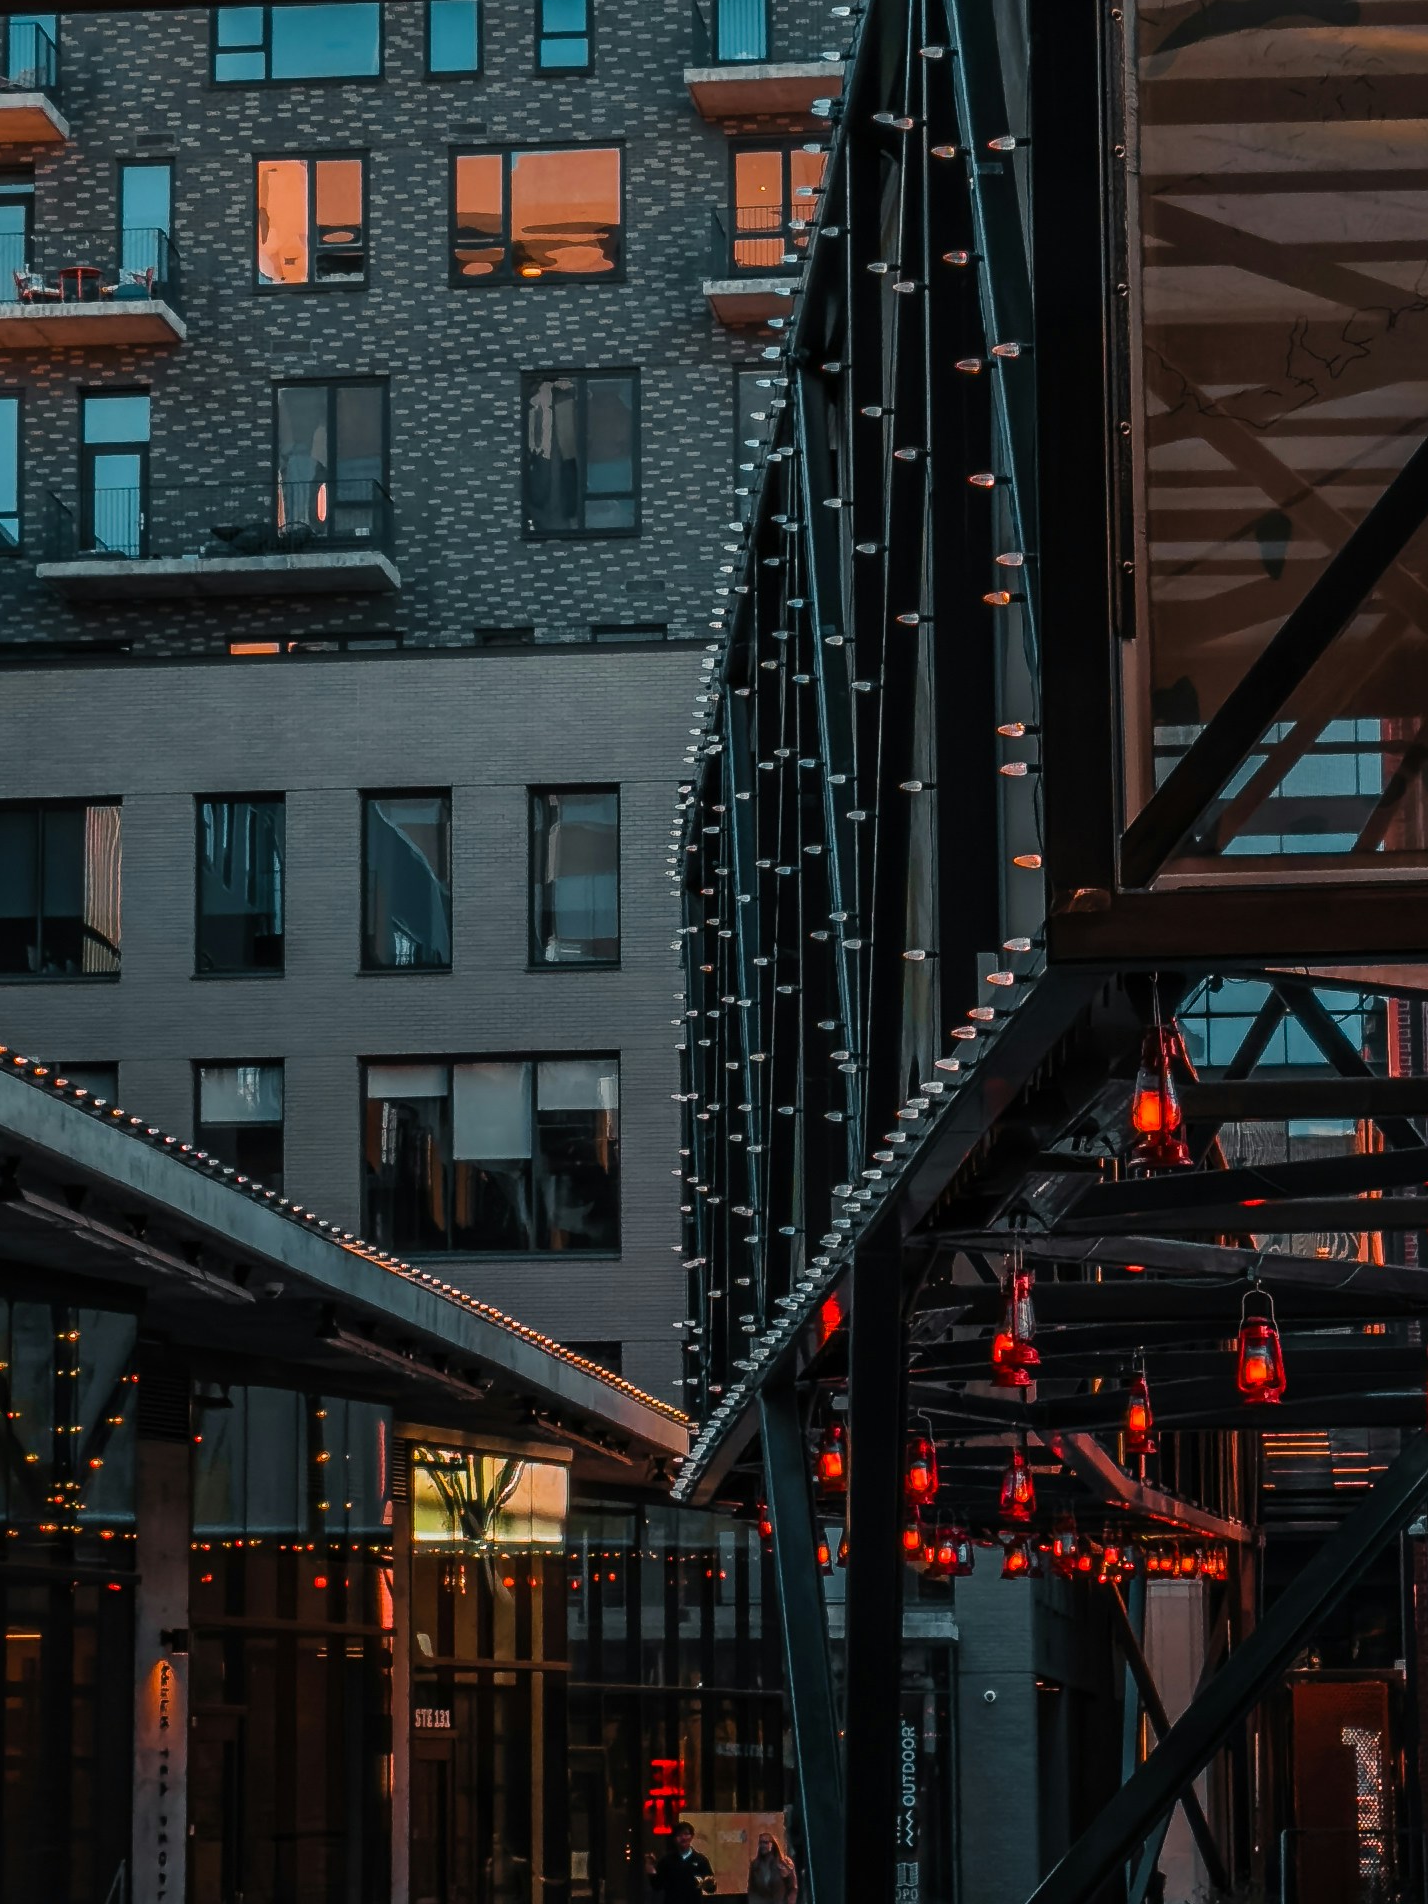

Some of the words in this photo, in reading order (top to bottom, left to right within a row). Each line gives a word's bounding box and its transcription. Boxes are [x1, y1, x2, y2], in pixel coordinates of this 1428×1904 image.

[415, 1708, 433, 1728] STE
[434, 1709, 451, 1728] 131
[901, 1726, 916, 1807] OUTDOOR
